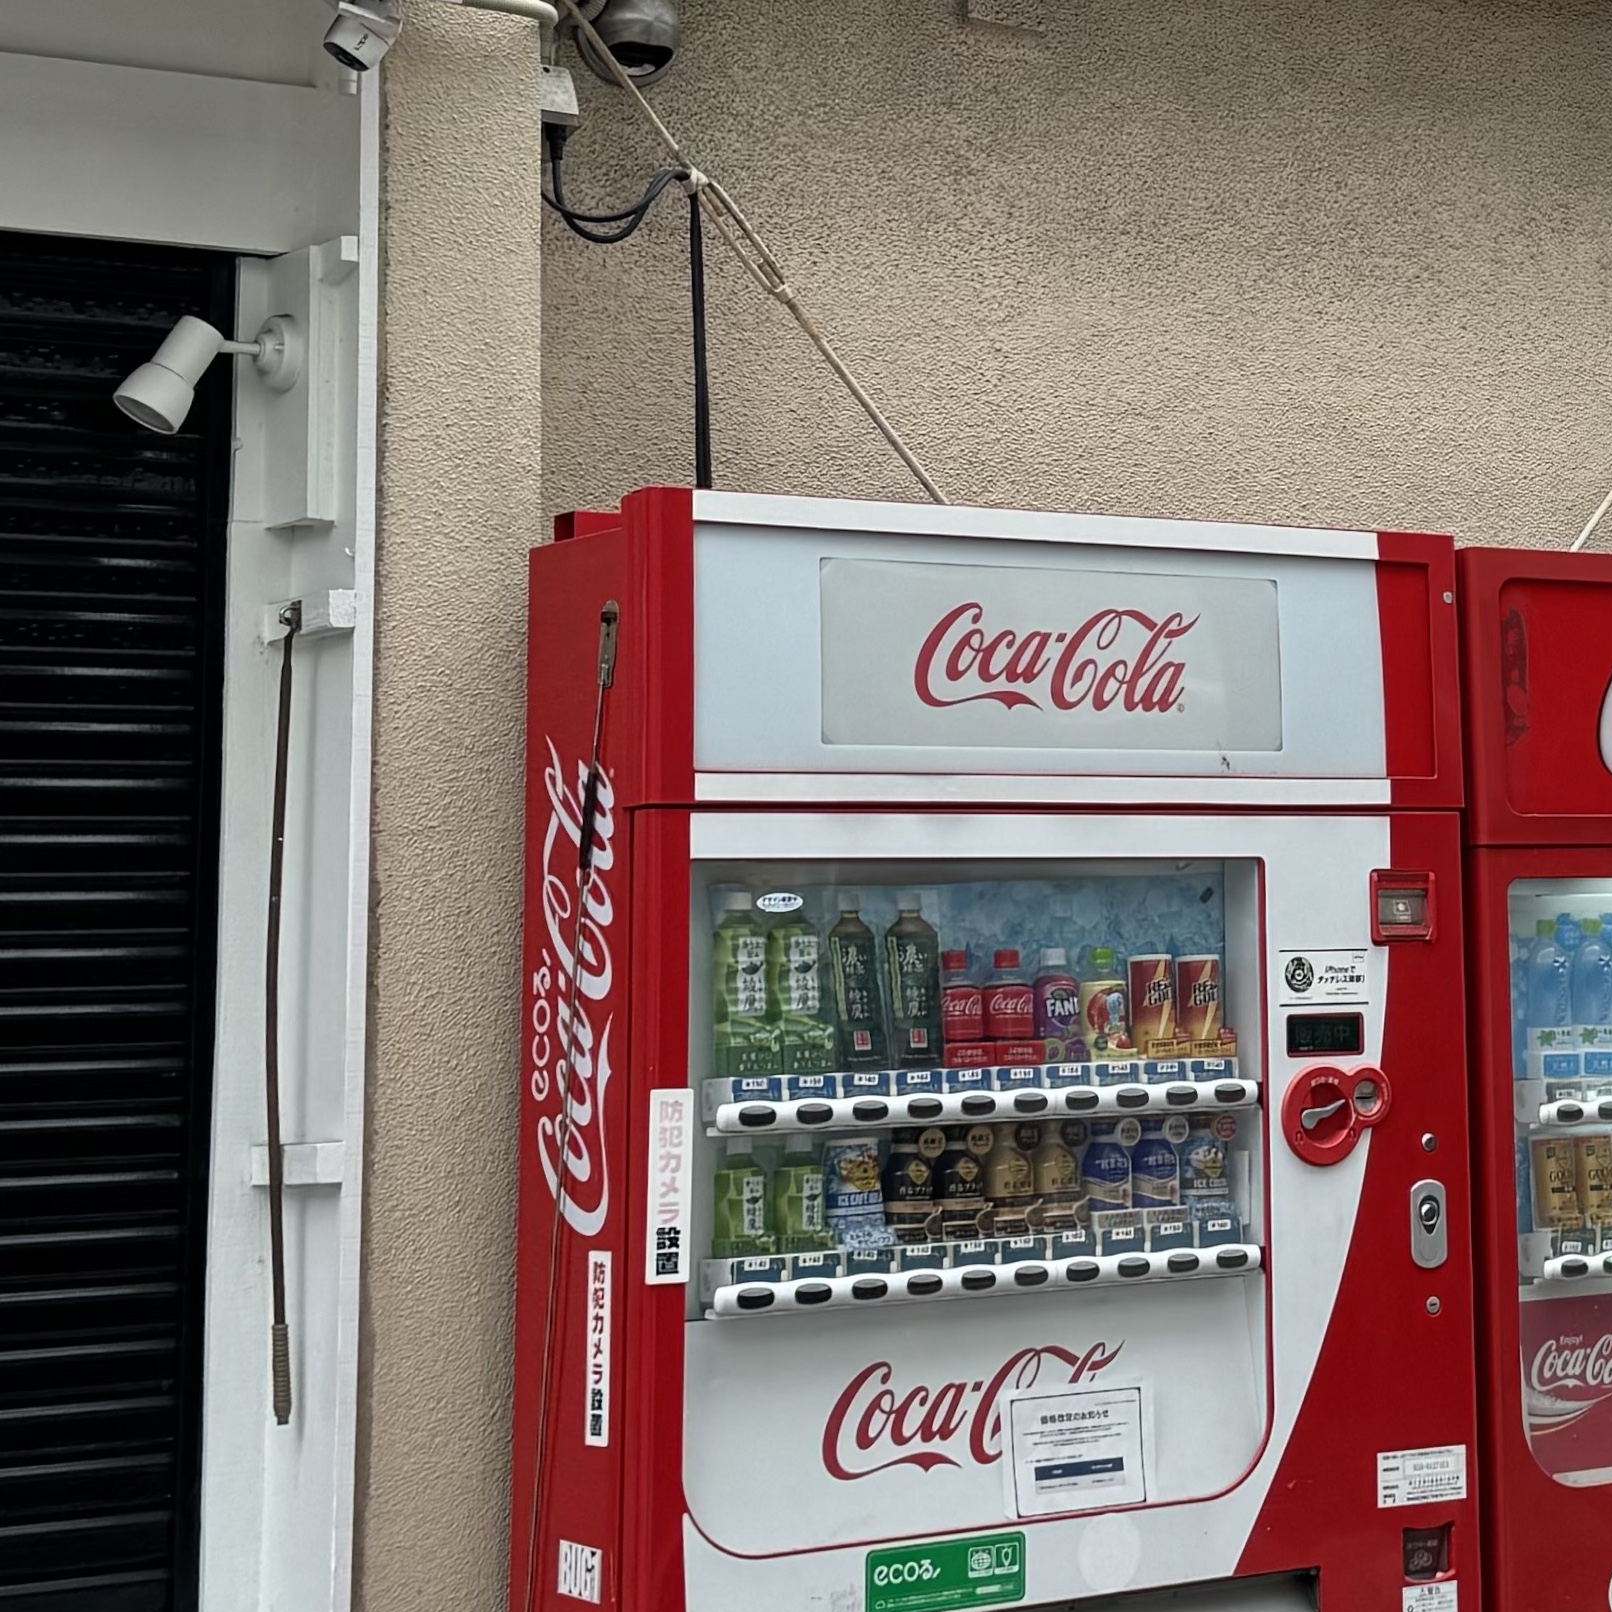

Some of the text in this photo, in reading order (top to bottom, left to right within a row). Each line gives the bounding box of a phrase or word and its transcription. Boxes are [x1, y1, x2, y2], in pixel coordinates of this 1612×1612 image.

[912, 600, 1202, 714] Coca-Cola
[655, 1099, 684, 1277] 防犯カメラ設置
[589, 1260, 606, 1438] 防犯カメラ設置
[821, 1339, 1127, 1482] Coca-C
